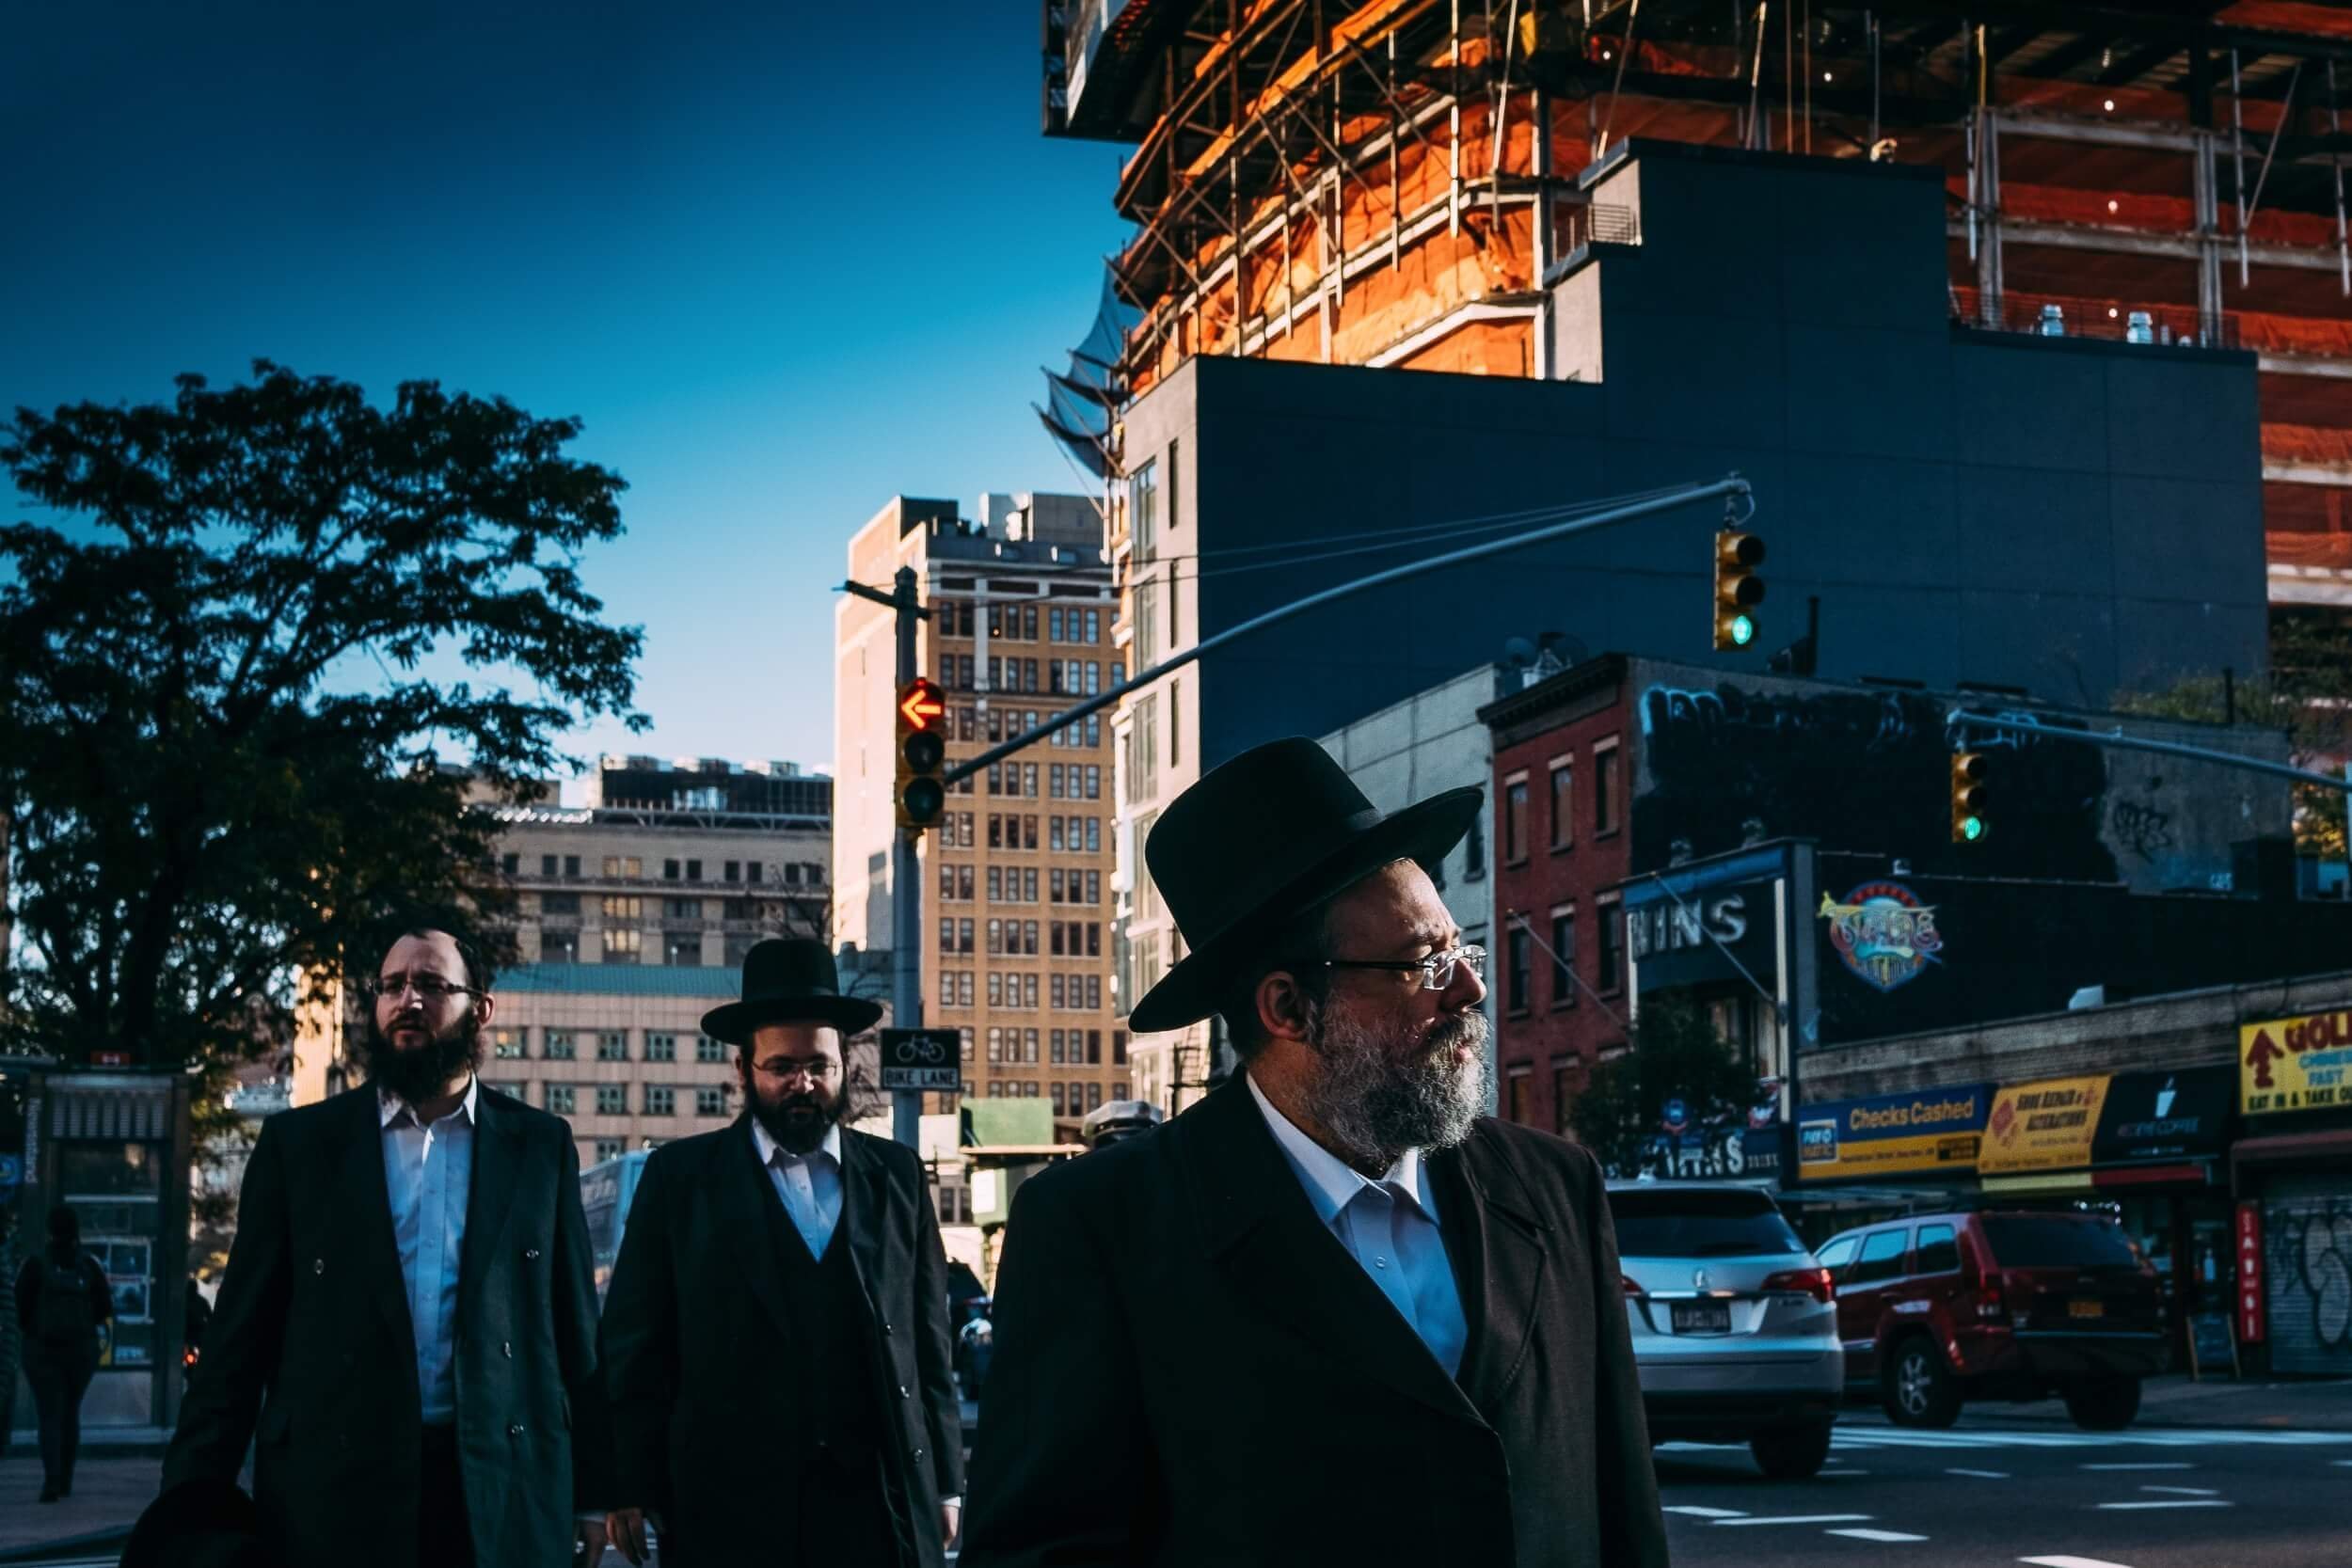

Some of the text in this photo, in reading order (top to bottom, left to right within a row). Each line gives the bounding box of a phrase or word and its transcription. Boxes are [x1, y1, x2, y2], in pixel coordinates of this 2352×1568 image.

[2284, 1010, 2352, 1052] GOL
[885, 1069, 957, 1085] BIKE LANE
[1850, 1093, 1975, 1131] Checks Cashed
[2248, 1095, 2268, 1111] EAT
[2304, 1087, 2334, 1106] TAKE
